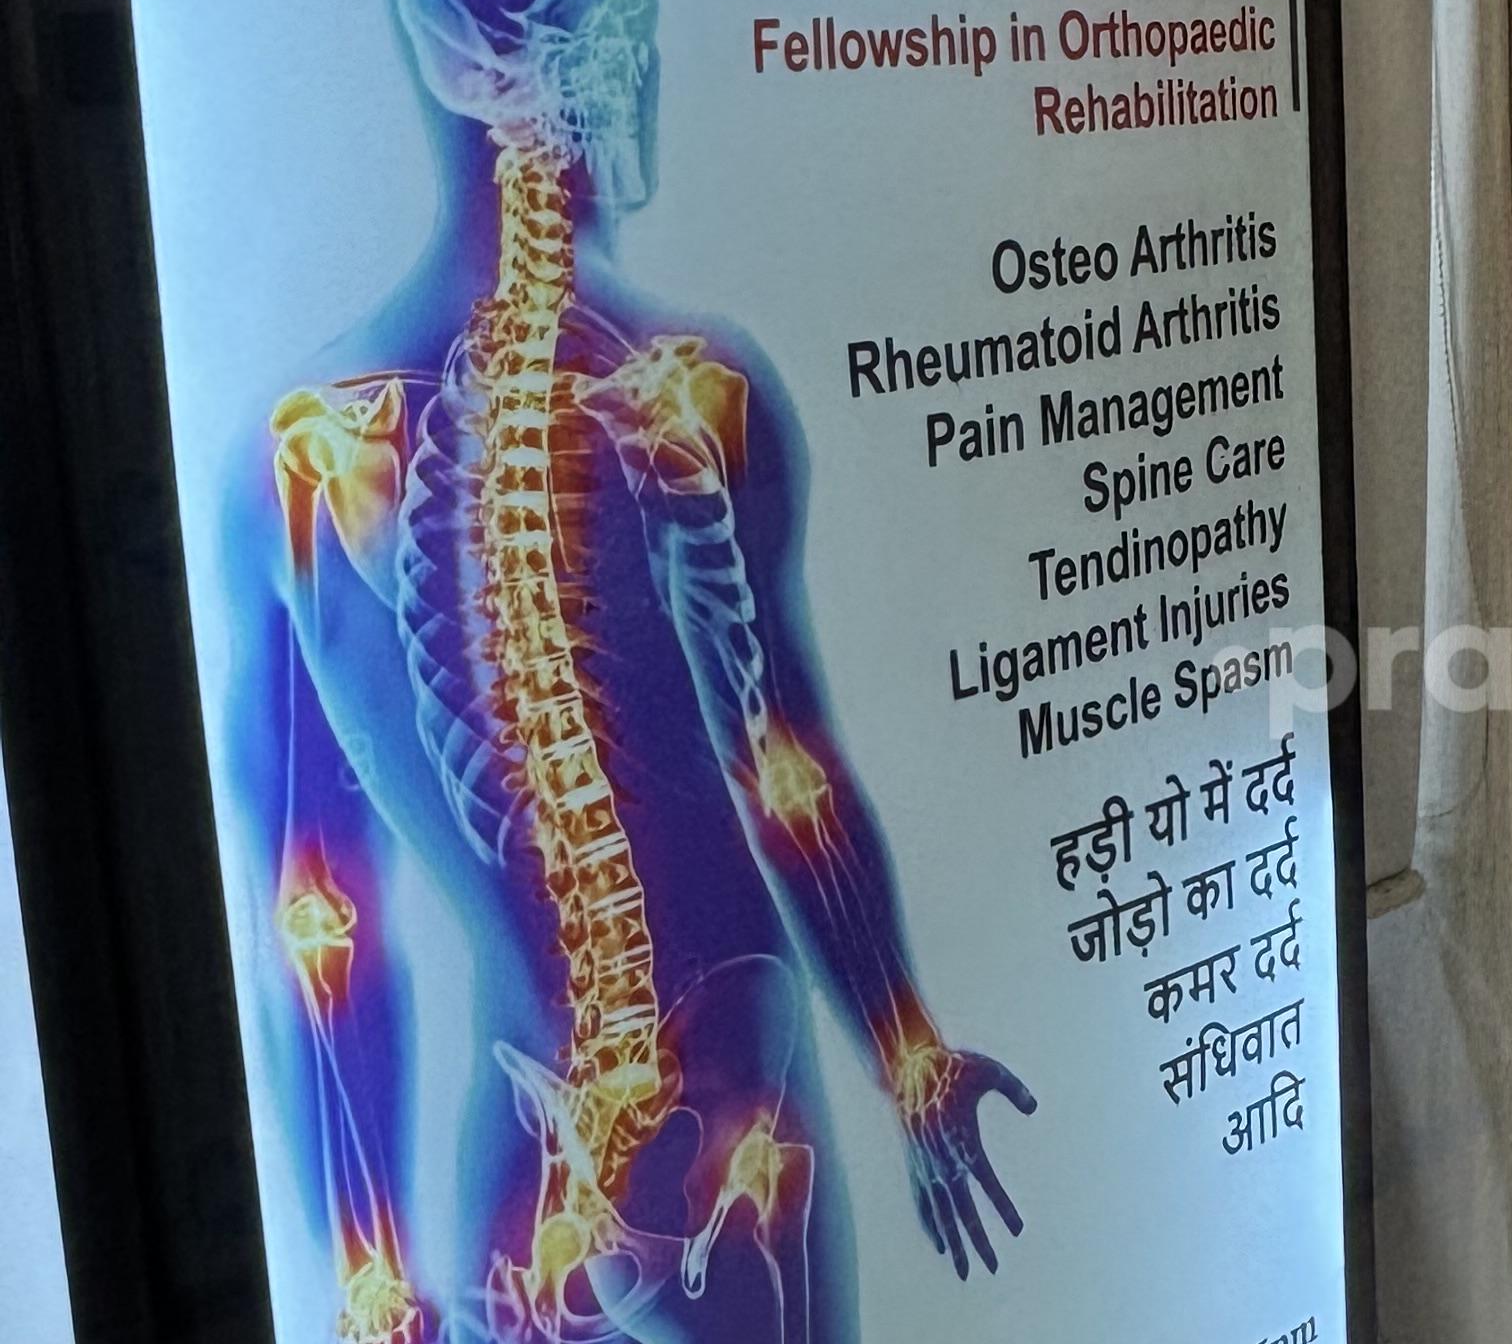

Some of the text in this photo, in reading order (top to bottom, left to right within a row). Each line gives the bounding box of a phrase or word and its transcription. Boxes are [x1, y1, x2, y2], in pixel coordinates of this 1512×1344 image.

[753, 5, 1277, 78] Fellowship in Orthopaedic
[1033, 75, 1279, 137] Rehabilitation
[992, 211, 1278, 294] Osteo Arthritis
[847, 283, 1282, 398] Rheumatoid Arthritis
[926, 354, 1285, 468] Pain Management
[1082, 434, 1287, 522] Spine Care
[1028, 498, 1288, 601] Tendinopathy
[948, 571, 1291, 703] Ligament Injuries
[1018, 640, 1293, 760] Muscle Spasm
[1144, 773, 1191, 847] यो
[1199, 758, 1234, 825] में
[1241, 732, 1297, 816] दर्द
[1181, 859, 1236, 921] का
[1245, 815, 1300, 900] दर्द
[1143, 898, 1304, 1025] कमर दर्द
[1158, 997, 1305, 1106] संधिवात
[1221, 1069, 1306, 1155] आदि
